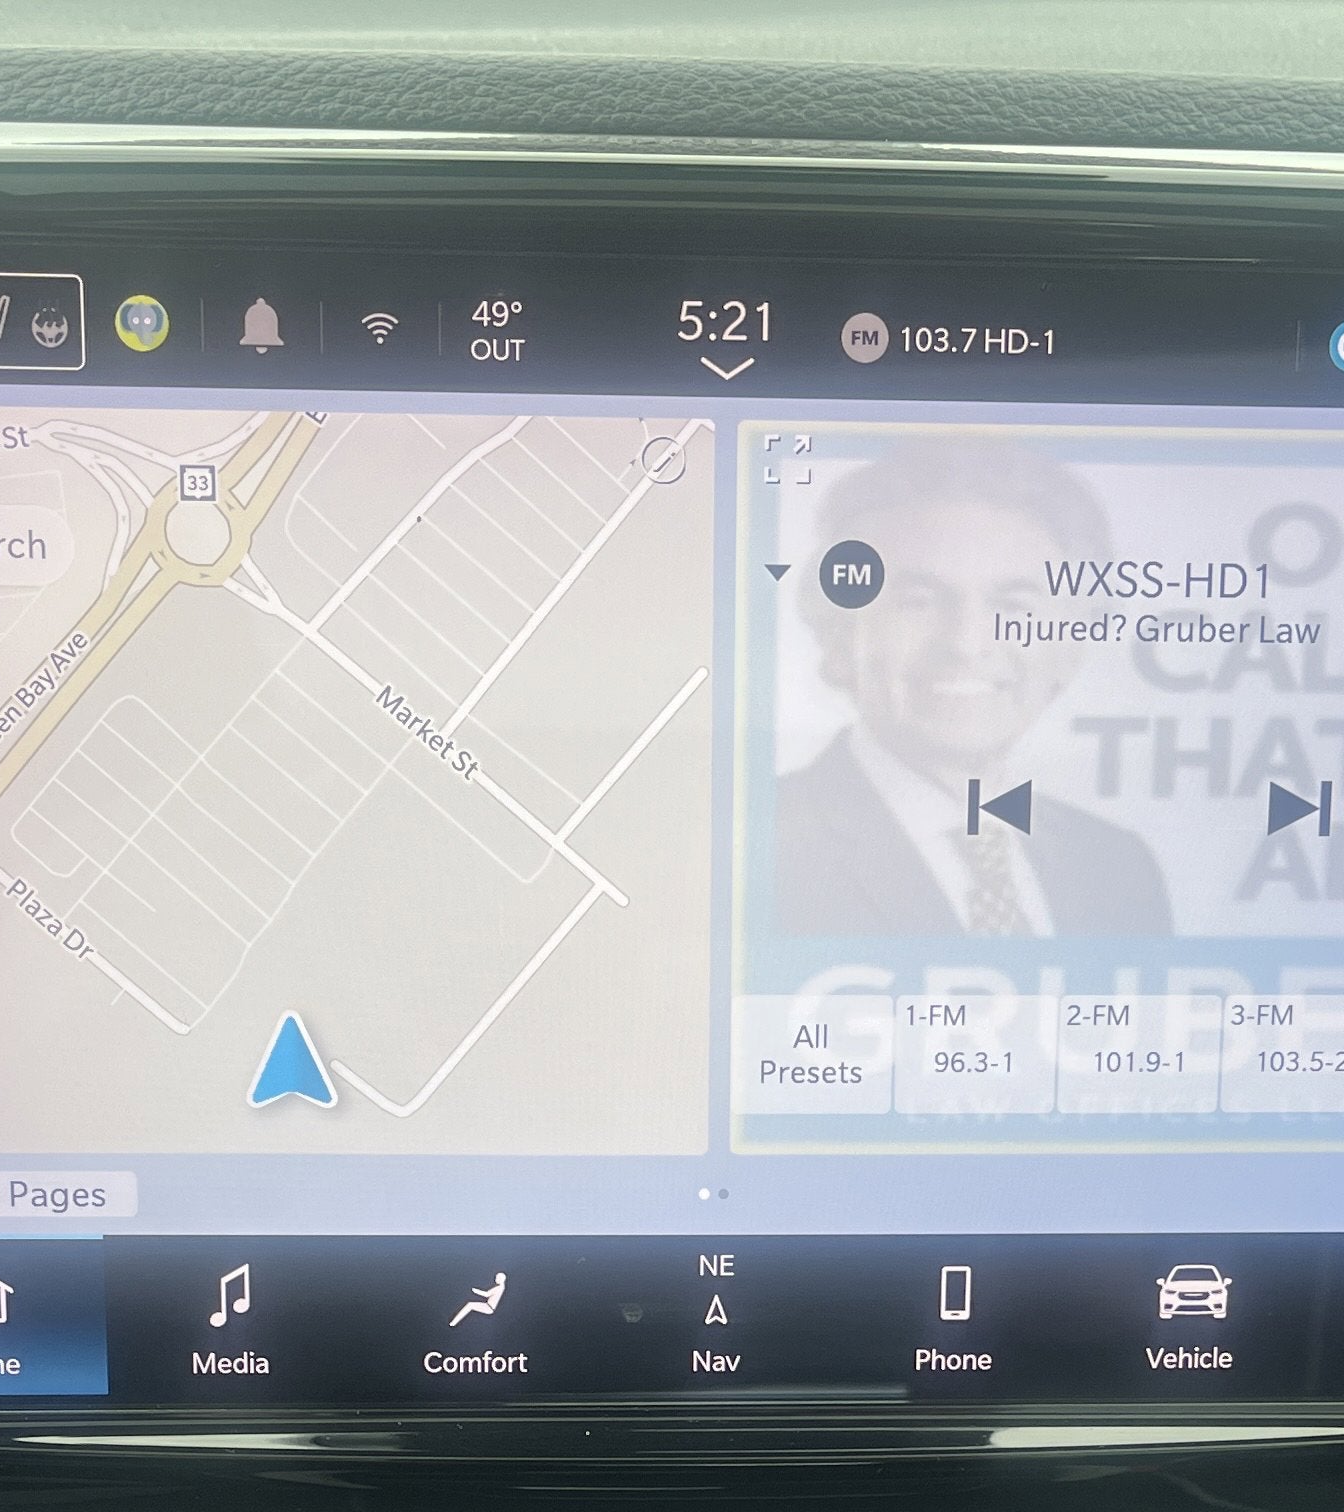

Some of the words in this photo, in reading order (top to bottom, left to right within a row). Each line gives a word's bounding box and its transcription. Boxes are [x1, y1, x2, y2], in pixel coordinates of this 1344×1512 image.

[677, 300, 772, 342] 5:21
[470, 338, 526, 362] OUT
[850, 330, 880, 347] FM
[900, 326, 976, 354] 103.7
[984, 328, 1054, 356] HD-1
[1, 425, 30, 449] St
[186, 474, 210, 492] 33
[832, 563, 871, 587] FM
[1044, 559, 1269, 599] WXSS-HD1
[993, 612, 1127, 648] Injured?
[1135, 614, 1251, 644] Gruber
[1259, 615, 1321, 644] Law
[15, 668, 55, 708] Bay
[50, 633, 88, 674] Ave
[375, 685, 454, 760] Market
[451, 750, 479, 780] St
[6, 878, 63, 937] Plaza
[62, 927, 95, 959] Dr
[906, 1003, 967, 1028] 1-FM
[1066, 1003, 1131, 1028] 2-FM
[1230, 1003, 1295, 1028] 3-FM
[792, 1024, 829, 1050] All
[758, 1058, 863, 1088] Presets
[933, 1049, 1015, 1074] 96.3-1
[1093, 1049, 1185, 1074] 101.9-1
[9, 1179, 106, 1214] Pages
[698, 1254, 735, 1277] NE
[192, 1351, 270, 1376] Media
[423, 1350, 528, 1376] Comfort
[692, 1349, 741, 1373] Nav
[914, 1346, 993, 1372] Phone
[1145, 1345, 1233, 1371] Vehicle
